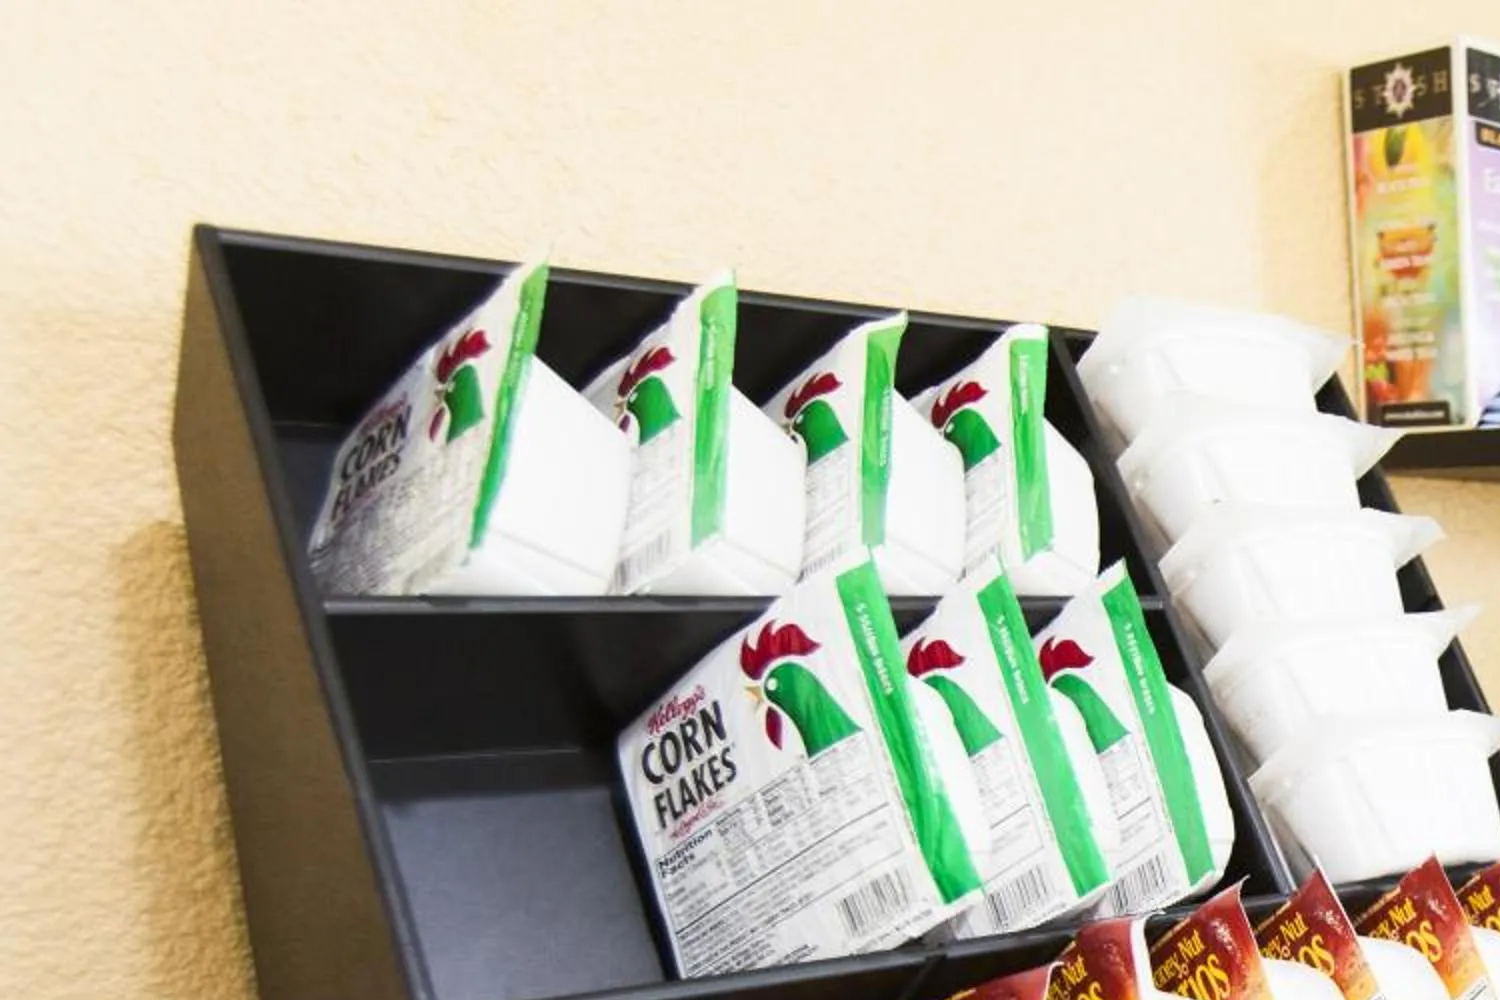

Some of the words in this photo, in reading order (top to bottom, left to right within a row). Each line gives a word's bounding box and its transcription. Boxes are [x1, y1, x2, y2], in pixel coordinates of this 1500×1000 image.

[341, 403, 412, 481] CORN
[641, 700, 727, 785] CORN
[653, 745, 737, 830] FLAKES
[658, 828, 714, 869] Nutrition
[1176, 927, 1206, 963] Nut
[1279, 910, 1310, 947] Nut
[1060, 952, 1089, 986] Nut
